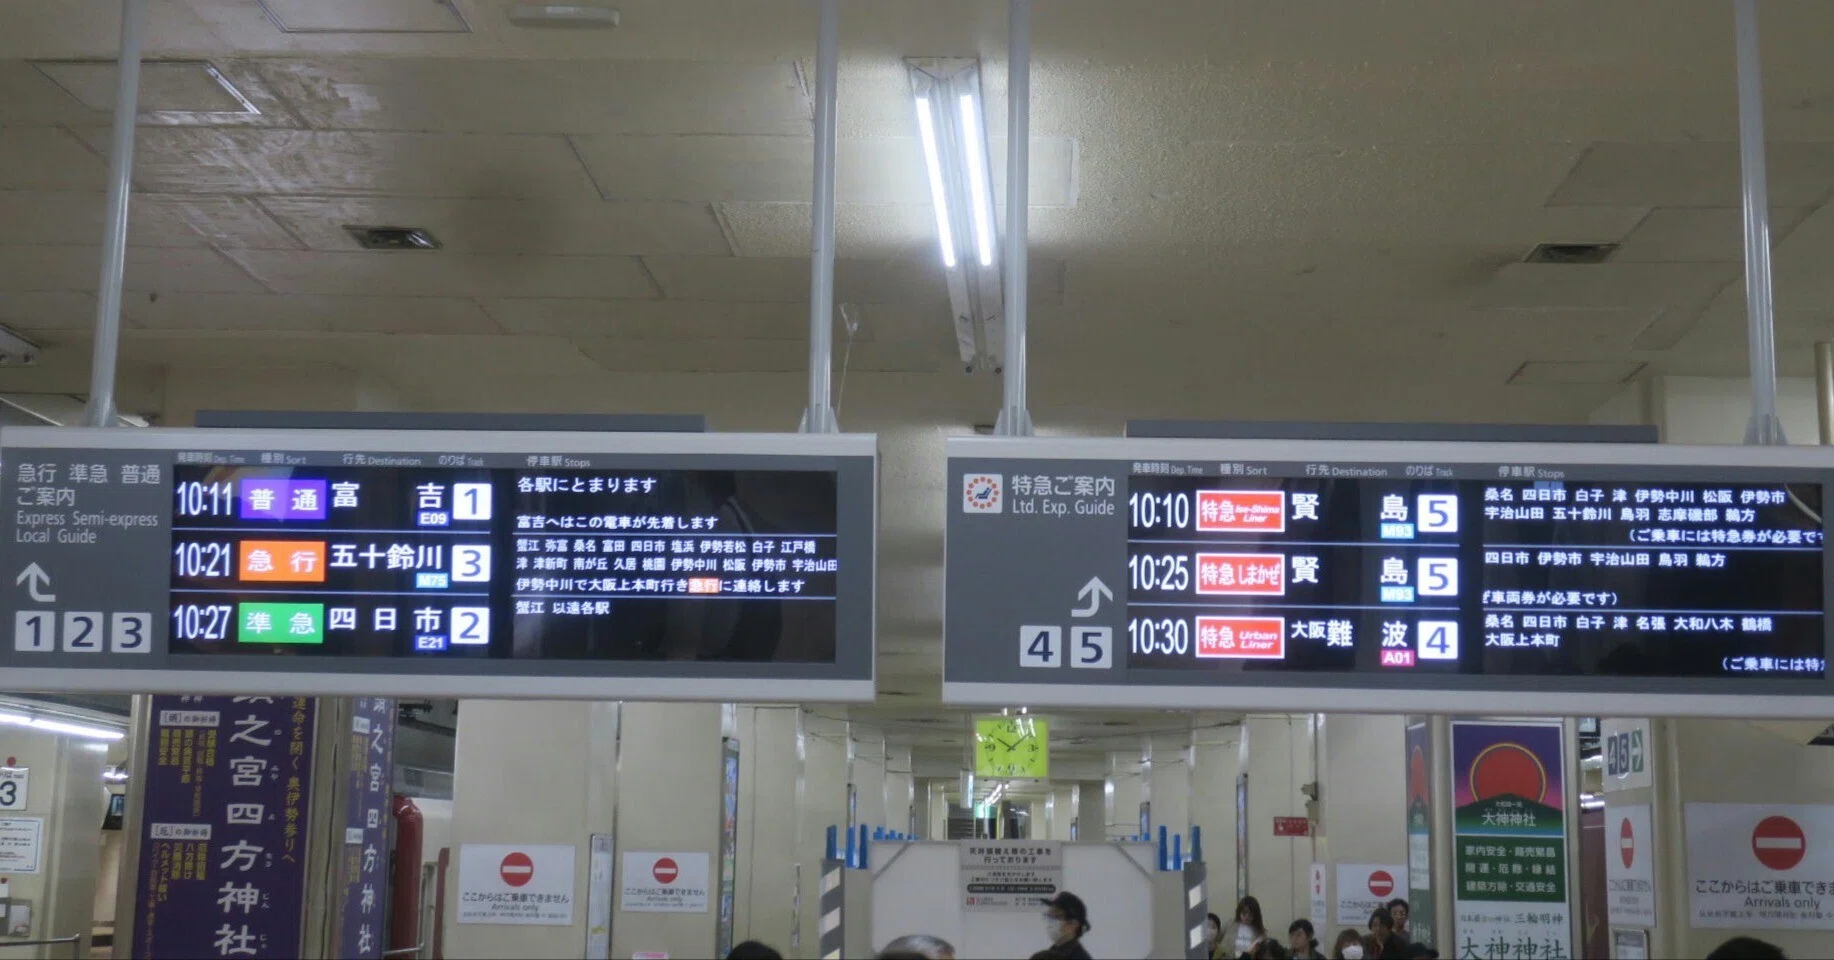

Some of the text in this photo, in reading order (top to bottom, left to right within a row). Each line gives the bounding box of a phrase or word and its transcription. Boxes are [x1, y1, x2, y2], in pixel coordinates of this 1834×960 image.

[287, 455, 307, 464] Sort
[343, 454, 421, 466] 行先 Destination
[438, 455, 465, 466] のりば
[527, 456, 591, 468] 停車駅 Stops
[17, 463, 161, 484] 急行 準急 普通
[1132, 463, 1170, 474] 発車時刻
[1220, 464, 1267, 475] 種別 Sort
[1305, 464, 1387, 477] 行先 Destination
[1405, 465, 1433, 476] のりば
[1498, 466, 1565, 479] 停車駅 Stops
[517, 477, 657, 493] 各駅にとまります
[1011, 475, 1115, 497] 特急ご案内
[17, 487, 75, 506] ご案内
[177, 481, 233, 516] 10:11
[464, 488, 478, 516] 1
[1485, 488, 1785, 504] 桑名 四日市 白子 津 伊勢中川 松阪 伊勢市
[1012, 499, 1115, 516] Ltd. Exp. Guide
[1129, 492, 1189, 528] 10:10
[1202, 501, 1236, 522] 特急
[1428, 500, 1448, 527] 5
[1485, 507, 1756, 522] 宇治山田 五十鈴川 鳥羽 志摩磯部 鵜方
[17, 510, 158, 530] Express Semi-express
[420, 512, 447, 525] E09
[516, 515, 719, 530] 富吉へはこの電車が先着します
[1243, 514, 1268, 523] Liner
[16, 528, 97, 544] Local Guide
[516, 539, 816, 554] 蟹江 弥富 桑名 富田 四日市 塩浜 伊勢若松 白子 江戸橋
[175, 542, 231, 577] 10:21
[330, 543, 443, 570] 五十鈴川
[461, 549, 482, 577] 3
[516, 557, 837, 572] 津 津新町 南が丘 久居 桃園 伊勢中川 松阪 伊勢市 宇治山田
[1485, 552, 1726, 567] 四日市 伊勢市 宇治山田 鳥羽 鵜方
[1129, 555, 1189, 590] 10:25
[1201, 563, 1235, 585] 特急
[1238, 562, 1281, 585] しまかぜ
[1428, 564, 1449, 590] 5
[516, 601, 610, 615] 蟹江 以遠各駅
[173, 605, 232, 639] 10:27
[459, 612, 480, 639] 2
[1485, 614, 1772, 631] 桑名 四日市 白子 津 名張 大和八木 鶴橋
[26, 615, 143, 649] 1 2 3
[1129, 618, 1188, 654] 10:30
[1201, 625, 1235, 648] 特急
[1426, 626, 1450, 654] 4
[1239, 631, 1277, 640] Urban
[417, 637, 443, 649] E21
[1027, 631, 1103, 663] 4 5
[1241, 640, 1274, 649] Liner
[1485, 633, 1560, 647] 大阪上本町
[1383, 651, 1412, 665] A01
[1482, 810, 1537, 827] 大神神社
[462, 892, 570, 903] ここからはご乗車できません
[1744, 896, 1821, 909] Arrivals only
[491, 903, 540, 912] Arrivals only
[1461, 936, 1568, 960] 大神神社
